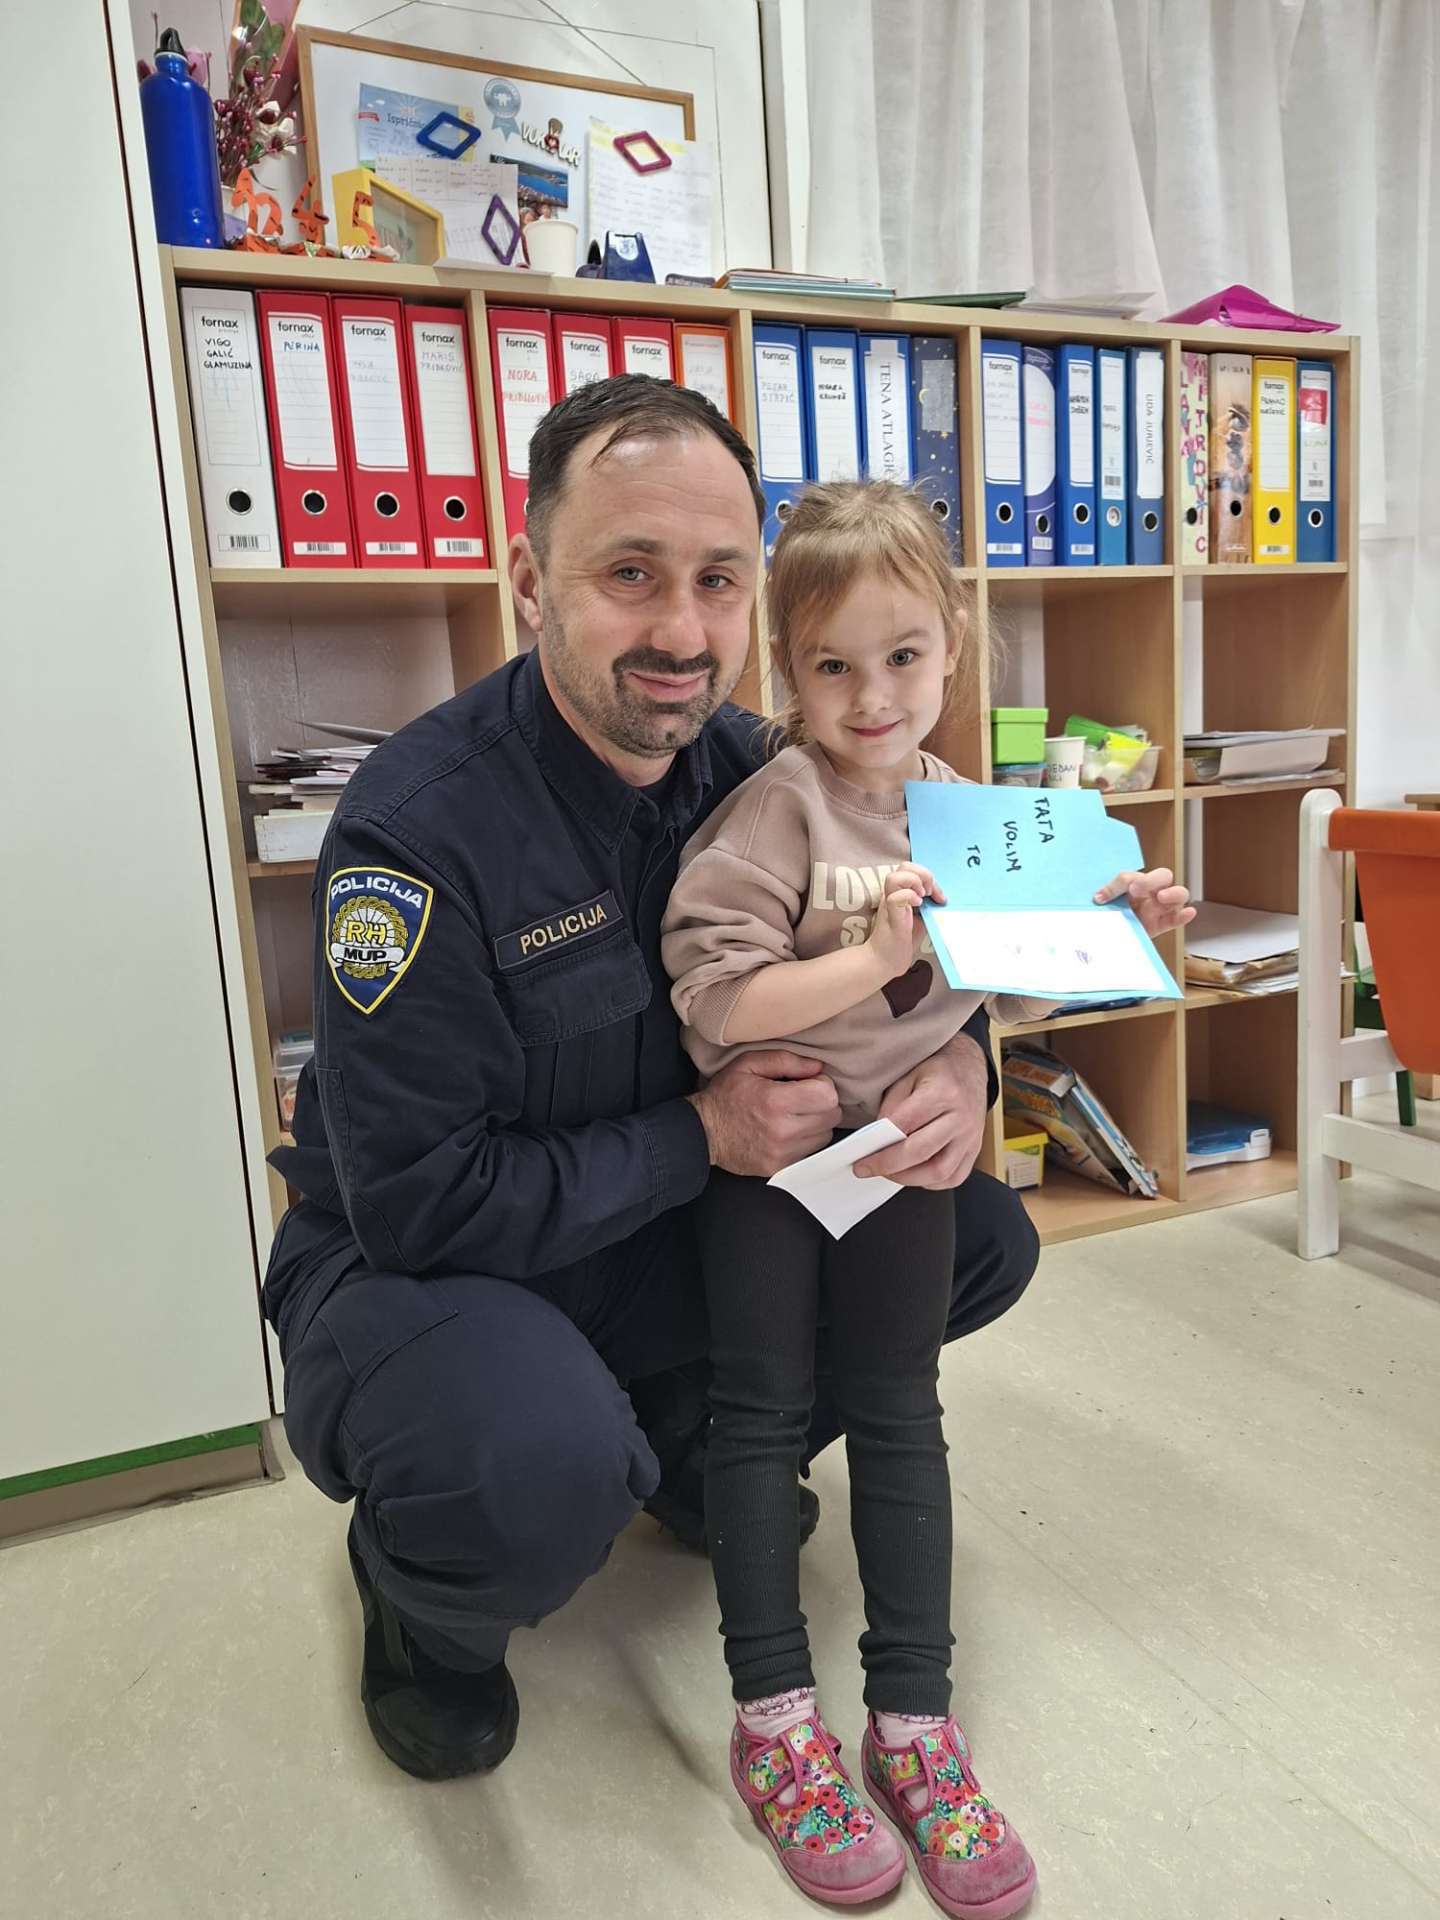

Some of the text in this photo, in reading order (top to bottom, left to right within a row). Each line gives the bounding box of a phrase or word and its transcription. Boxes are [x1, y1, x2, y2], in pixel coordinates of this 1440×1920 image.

[201, 315, 239, 329] fornax
[278, 321, 315, 333] fornax
[351, 324, 386, 337] fornax
[421, 331, 455, 344] fornax
[204, 338, 232, 348] VIGO
[506, 338, 539, 350] fornax
[570, 341, 601, 353] fornax
[631, 344, 662, 356] fornax
[762, 350, 791, 361] fornax
[819, 355, 848, 366] fornax
[508, 368, 538, 382] NORA
[880, 362, 892, 404] TENA
[1034, 796, 1055, 843] TATA
[1003, 821, 1022, 872] VOLIM
[331, 876, 423, 909] POLICIJA
[812, 861, 900, 911] LOV
[345, 921, 387, 945] RH
[520, 903, 608, 955] POLICIJA
[343, 947, 387, 961] MUP
